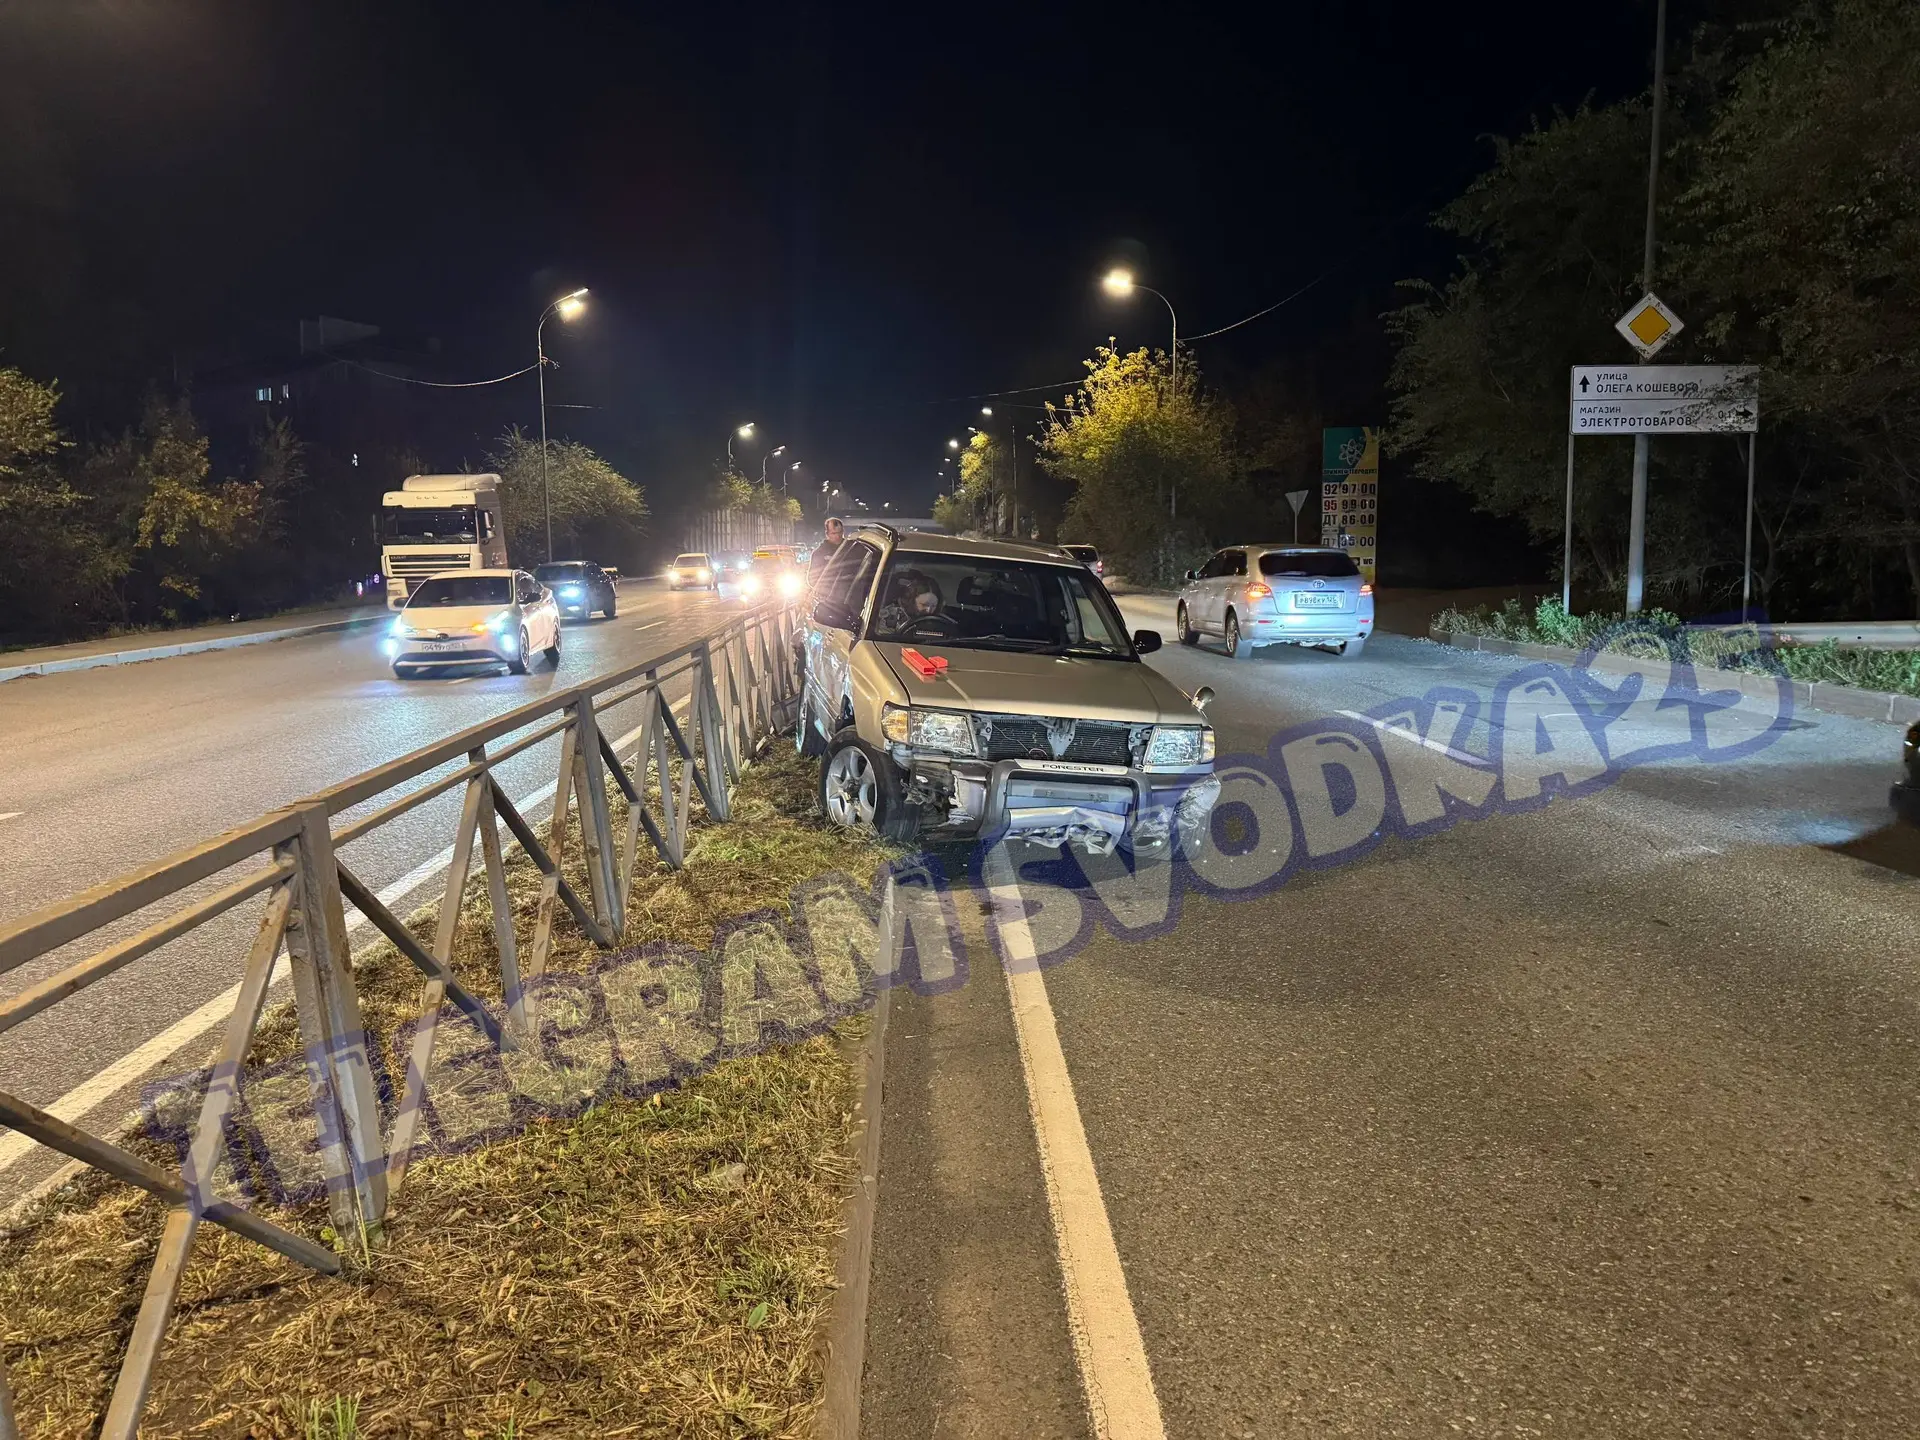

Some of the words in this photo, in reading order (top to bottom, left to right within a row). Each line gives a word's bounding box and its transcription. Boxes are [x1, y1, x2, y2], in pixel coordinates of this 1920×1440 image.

[1597, 372, 1628, 381] улица
[1596, 383, 1633, 393] ОЛЕГА
[1636, 382, 1699, 393] КОШЕВОГО
[1579, 406, 1622, 414] МАГАЗИН
[1580, 416, 1693, 428] ЭЛЕКТРОТОВАРОВ
[1324, 483, 1338, 495] 92
[1323, 499, 1338, 511] 95
[1322, 514, 1338, 526] ДТ
[1042, 763, 1105, 773] FORESTER
